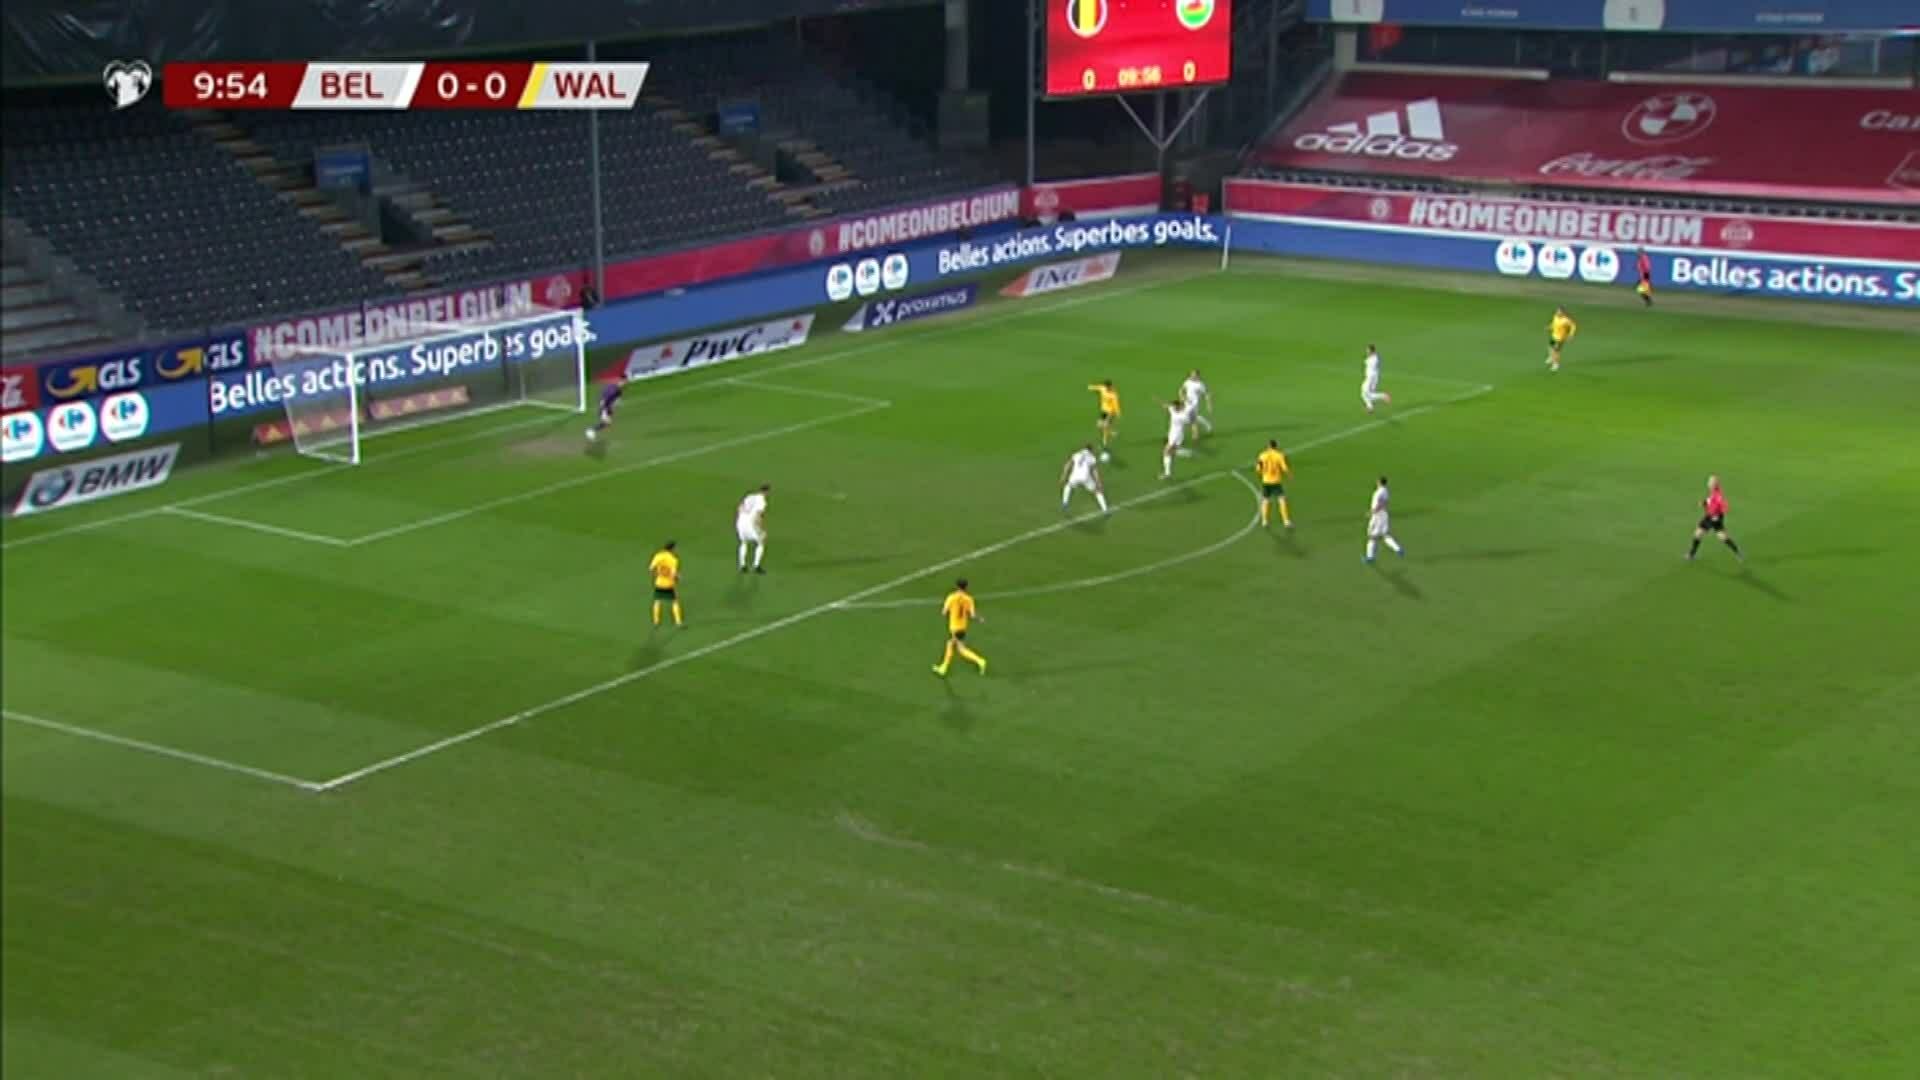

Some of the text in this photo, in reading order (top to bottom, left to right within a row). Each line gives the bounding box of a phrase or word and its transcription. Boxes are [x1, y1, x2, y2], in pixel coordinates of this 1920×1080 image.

[1083, 69, 1096, 90] 0
[1183, 61, 1196, 82] 0
[1294, 131, 1458, 162] adidas
[838, 190, 1020, 252] #COMEONBELGIUM
[1408, 197, 1704, 245] #COMEONBELGIUM
[938, 241, 989, 275] Belles
[1054, 217, 1150, 253] Superbes
[1153, 215, 1219, 246] goals.
[1671, 257, 1920, 300] Belles actions. S
[99, 358, 141, 390] GLS
[205, 340, 243, 369] GLS
[211, 371, 297, 413] Belles
[302, 356, 406, 395] actons.
[528, 319, 598, 360] goas.
[77, 452, 170, 494] BMW
